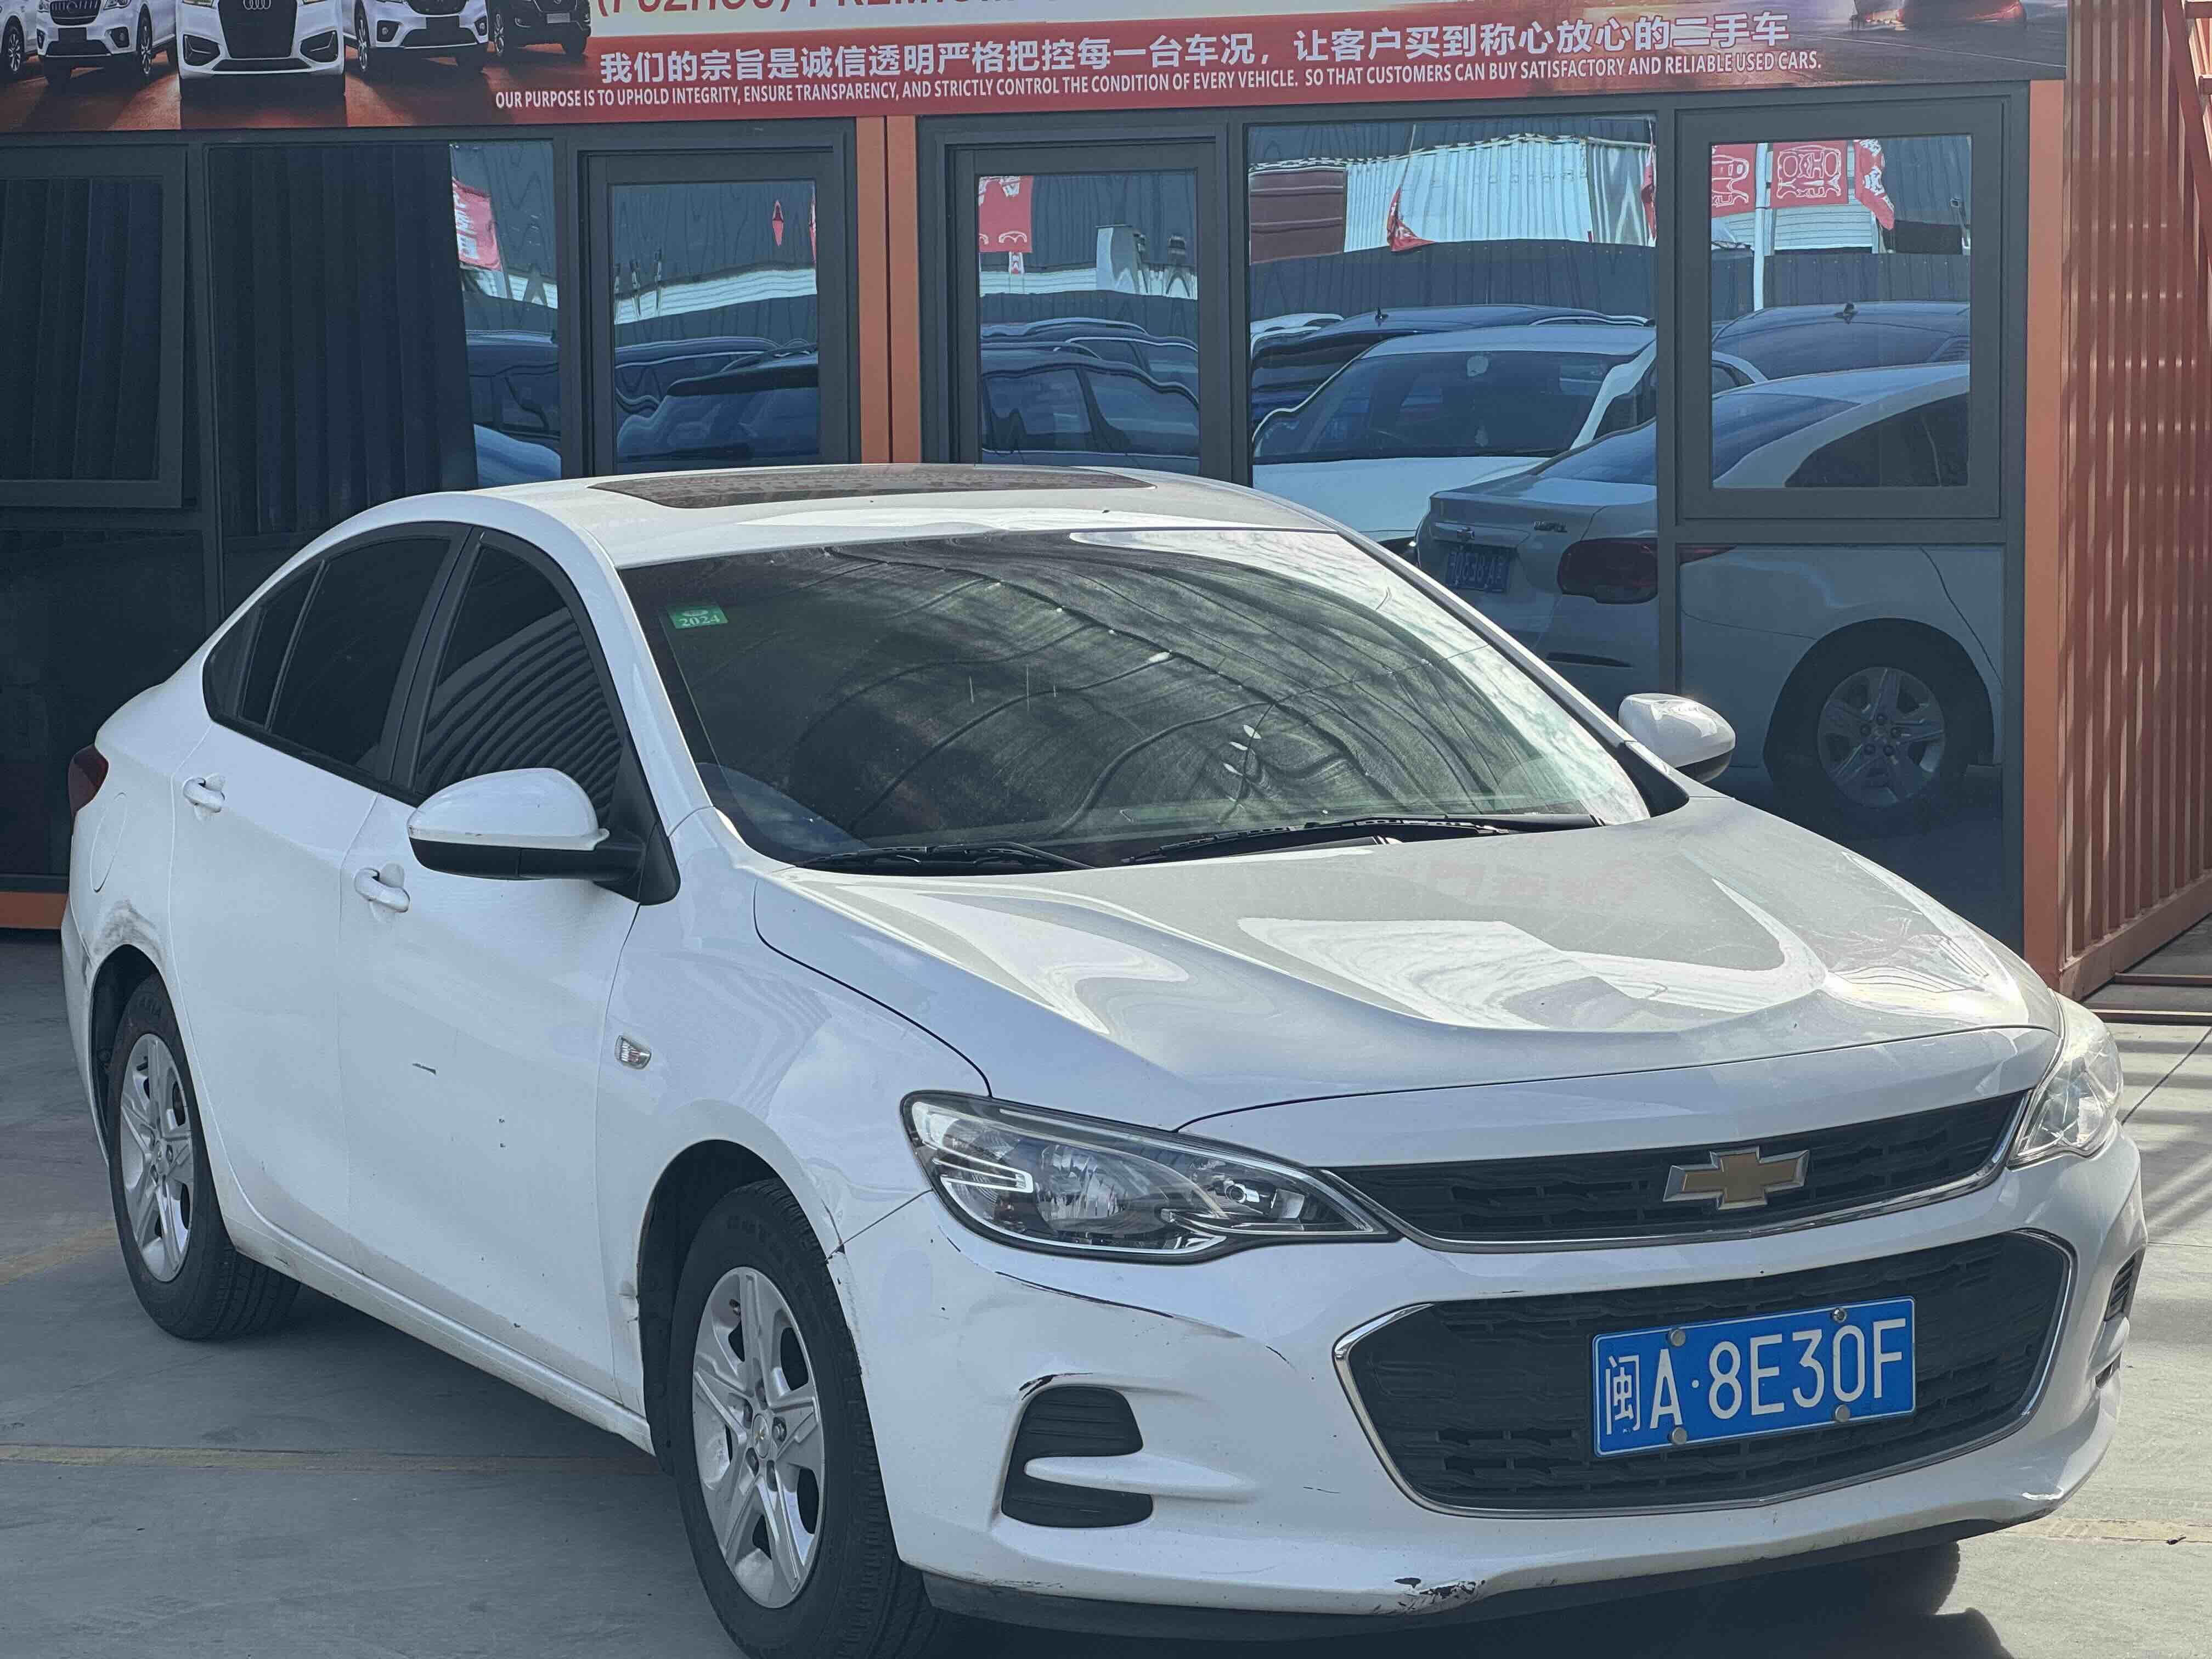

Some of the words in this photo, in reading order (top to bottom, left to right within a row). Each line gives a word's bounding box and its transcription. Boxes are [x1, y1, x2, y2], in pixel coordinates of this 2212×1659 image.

[495, 91, 523, 109] OUR
[524, 89, 582, 108] PURPOSE
[583, 89, 595, 107] IS
[596, 89, 614, 106] TO
[617, 87, 670, 106] UPHOLD
[672, 86, 741, 106] INTEGRITY,
[743, 84, 793, 103] ENSURE
[794, 81, 899, 101] TRANSPARENCY,
[902, 80, 932, 99] AND
[934, 78, 994, 97] STRICTLY
[996, 77, 1060, 96] CONTROL
[1062, 76, 1089, 94] THE
[1091, 72, 1169, 93] CONDITION
[1172, 72, 1190, 90] OF
[1193, 70, 1235, 90] EVERY
[1237, 69, 1299, 88] VEHICLE.
[1305, 68, 1324, 87] SO
[1326, 66, 1364, 86] THAT
[1366, 63, 1452, 84] CUSTOMERS
[1454, 61, 1486, 81] CAN
[1489, 61, 1519, 80] BUY
[1520, 57, 1625, 80] SATISFACTORY
[1628, 56, 1662, 76] AND
[1664, 53, 1734, 75] RELIABLE
[1735, 52, 1775, 72] USED
[1777, 50, 1821, 70] CARS.
[679, 614, 720, 627] 2024
